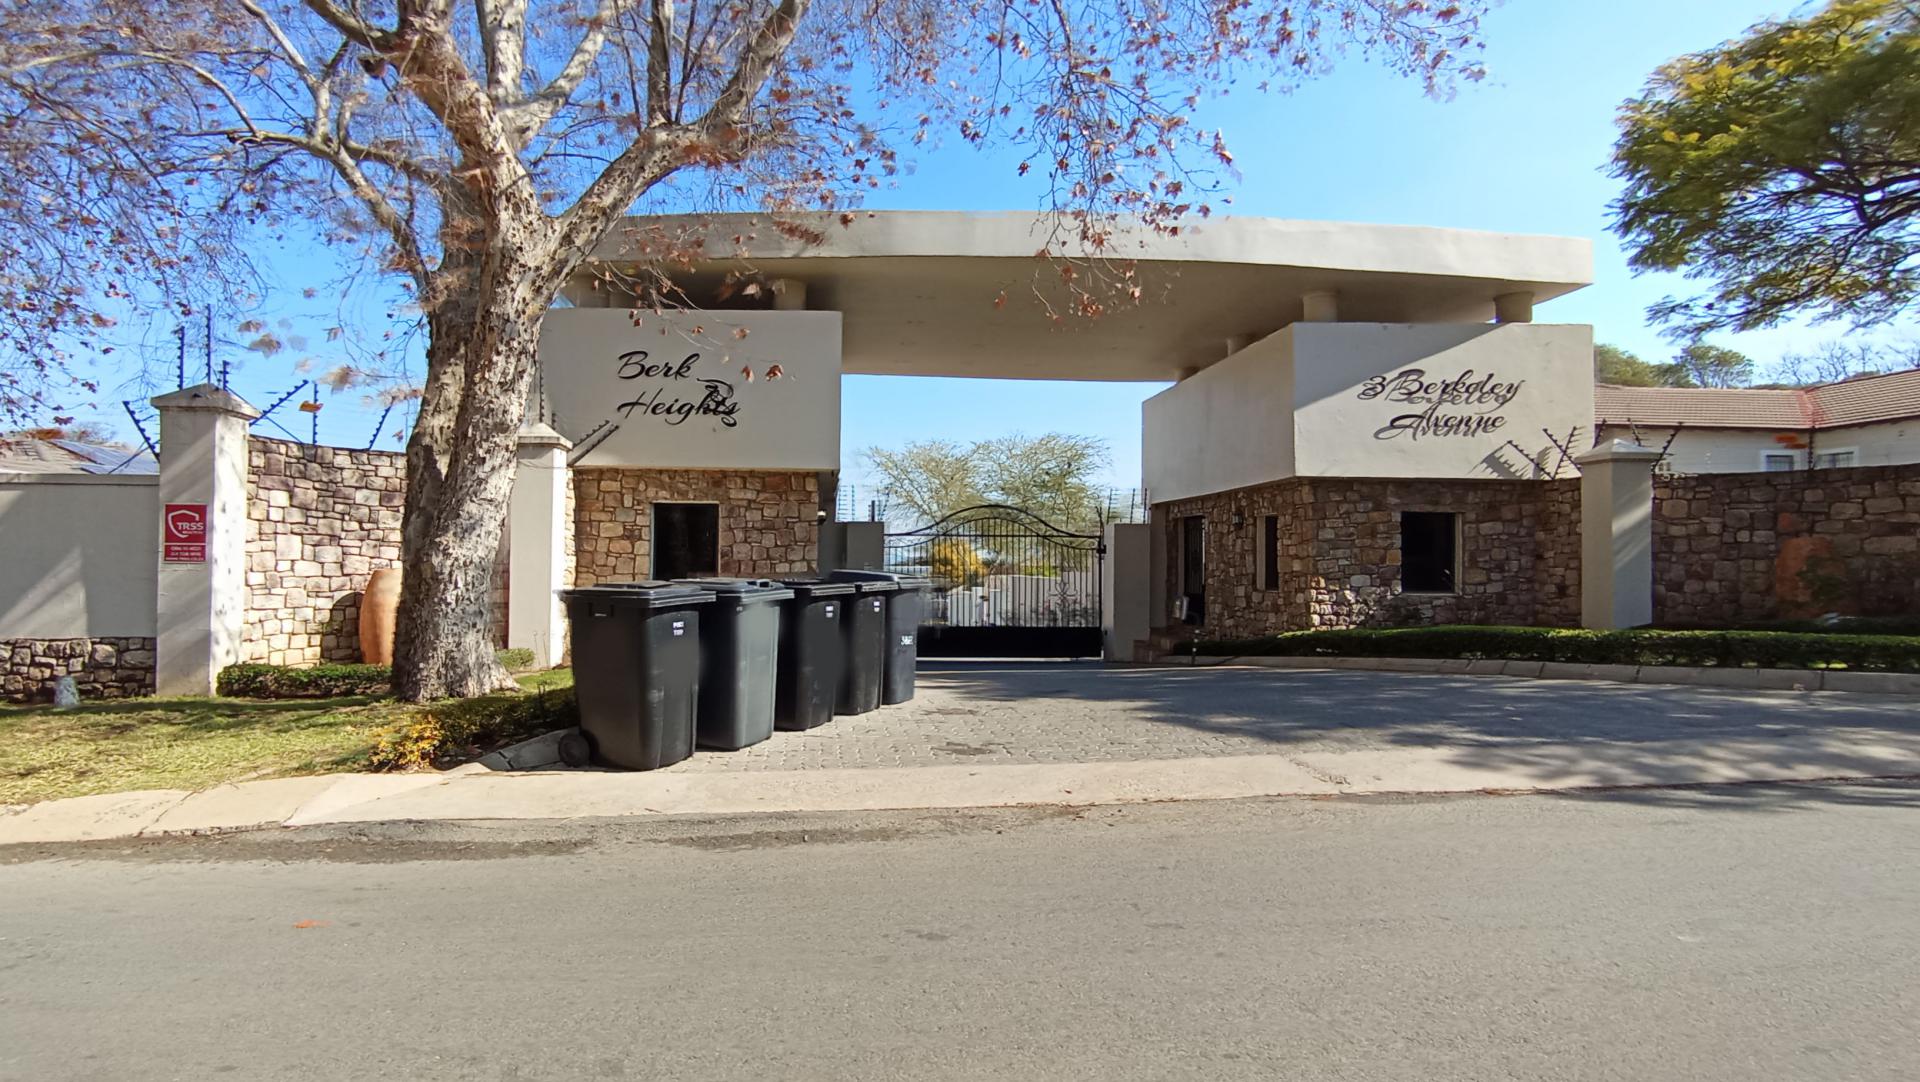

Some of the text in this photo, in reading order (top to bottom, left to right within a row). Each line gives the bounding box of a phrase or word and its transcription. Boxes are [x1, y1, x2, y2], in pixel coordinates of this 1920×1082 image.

[618, 350, 700, 381] Berk
[617, 378, 741, 427] Heights
[1361, 368, 1526, 415] 3 Berkeley
[1382, 402, 1507, 437] Avenue
[176, 522, 204, 530] TRSS
